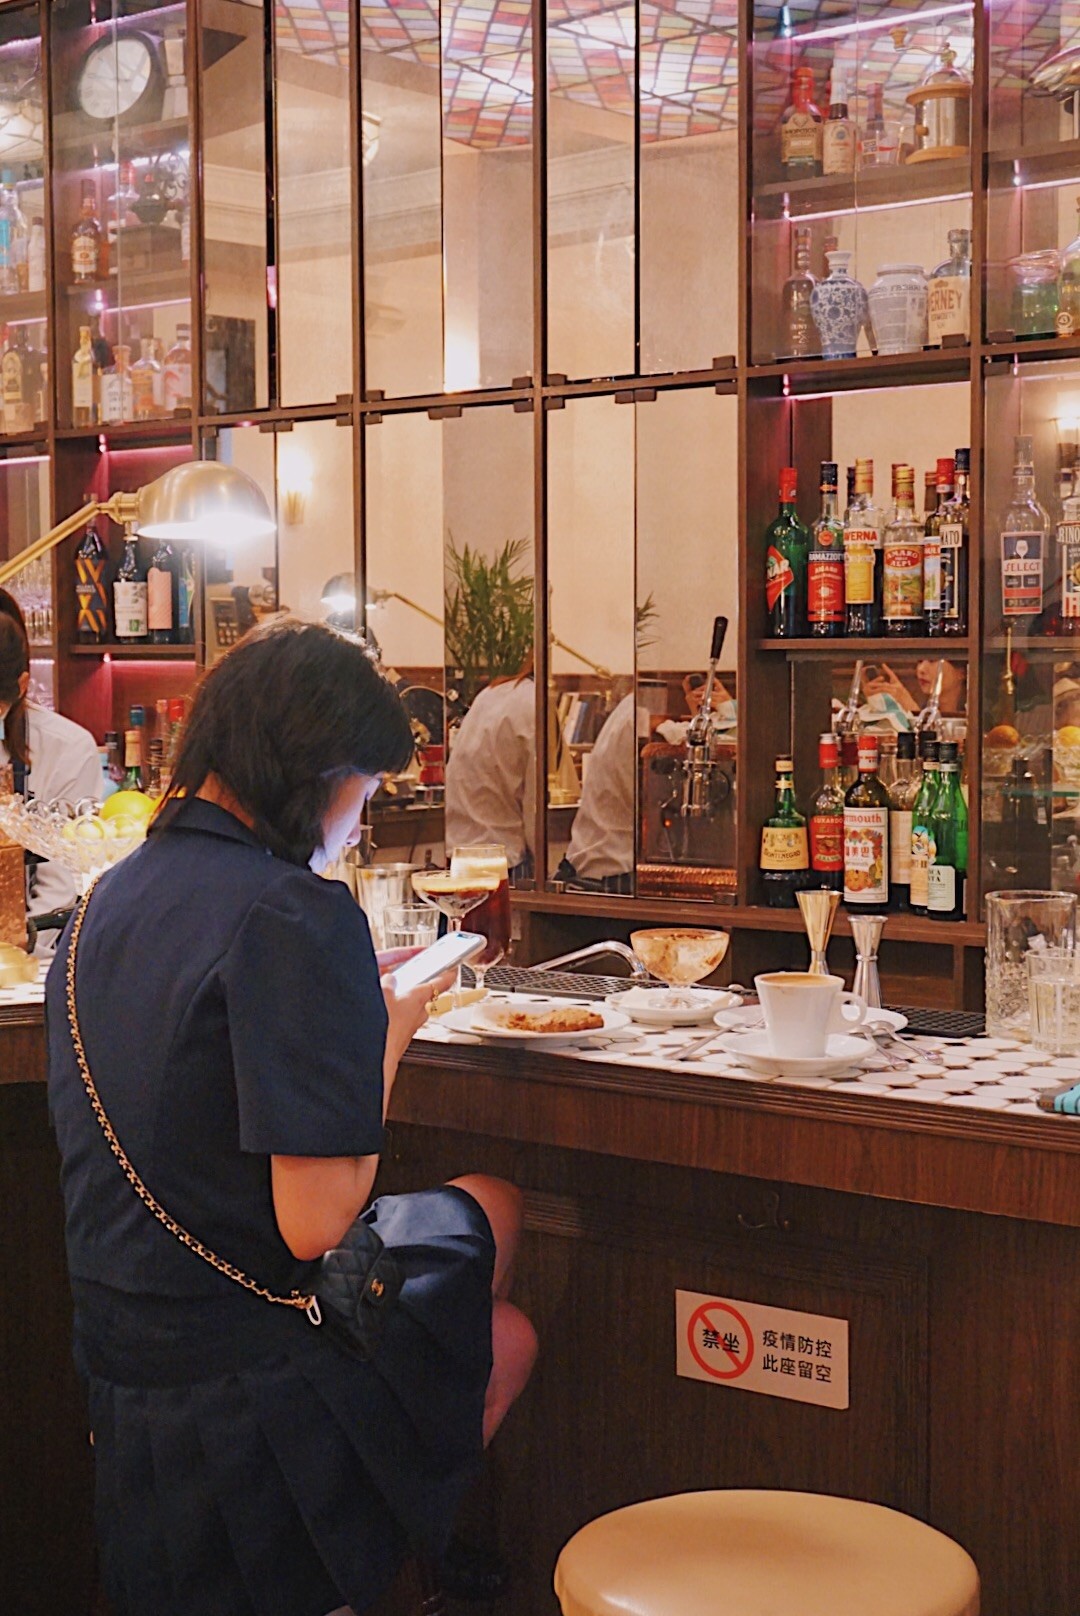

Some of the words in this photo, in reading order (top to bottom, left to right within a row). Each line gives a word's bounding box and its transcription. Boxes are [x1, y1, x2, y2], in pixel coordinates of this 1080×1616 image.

[1004, 562, 1040, 572] SELECT
[702, 1329, 740, 1354] 禁坐
[762, 1330, 832, 1359] 疫情防控
[762, 1354, 832, 1383] 此座留空
